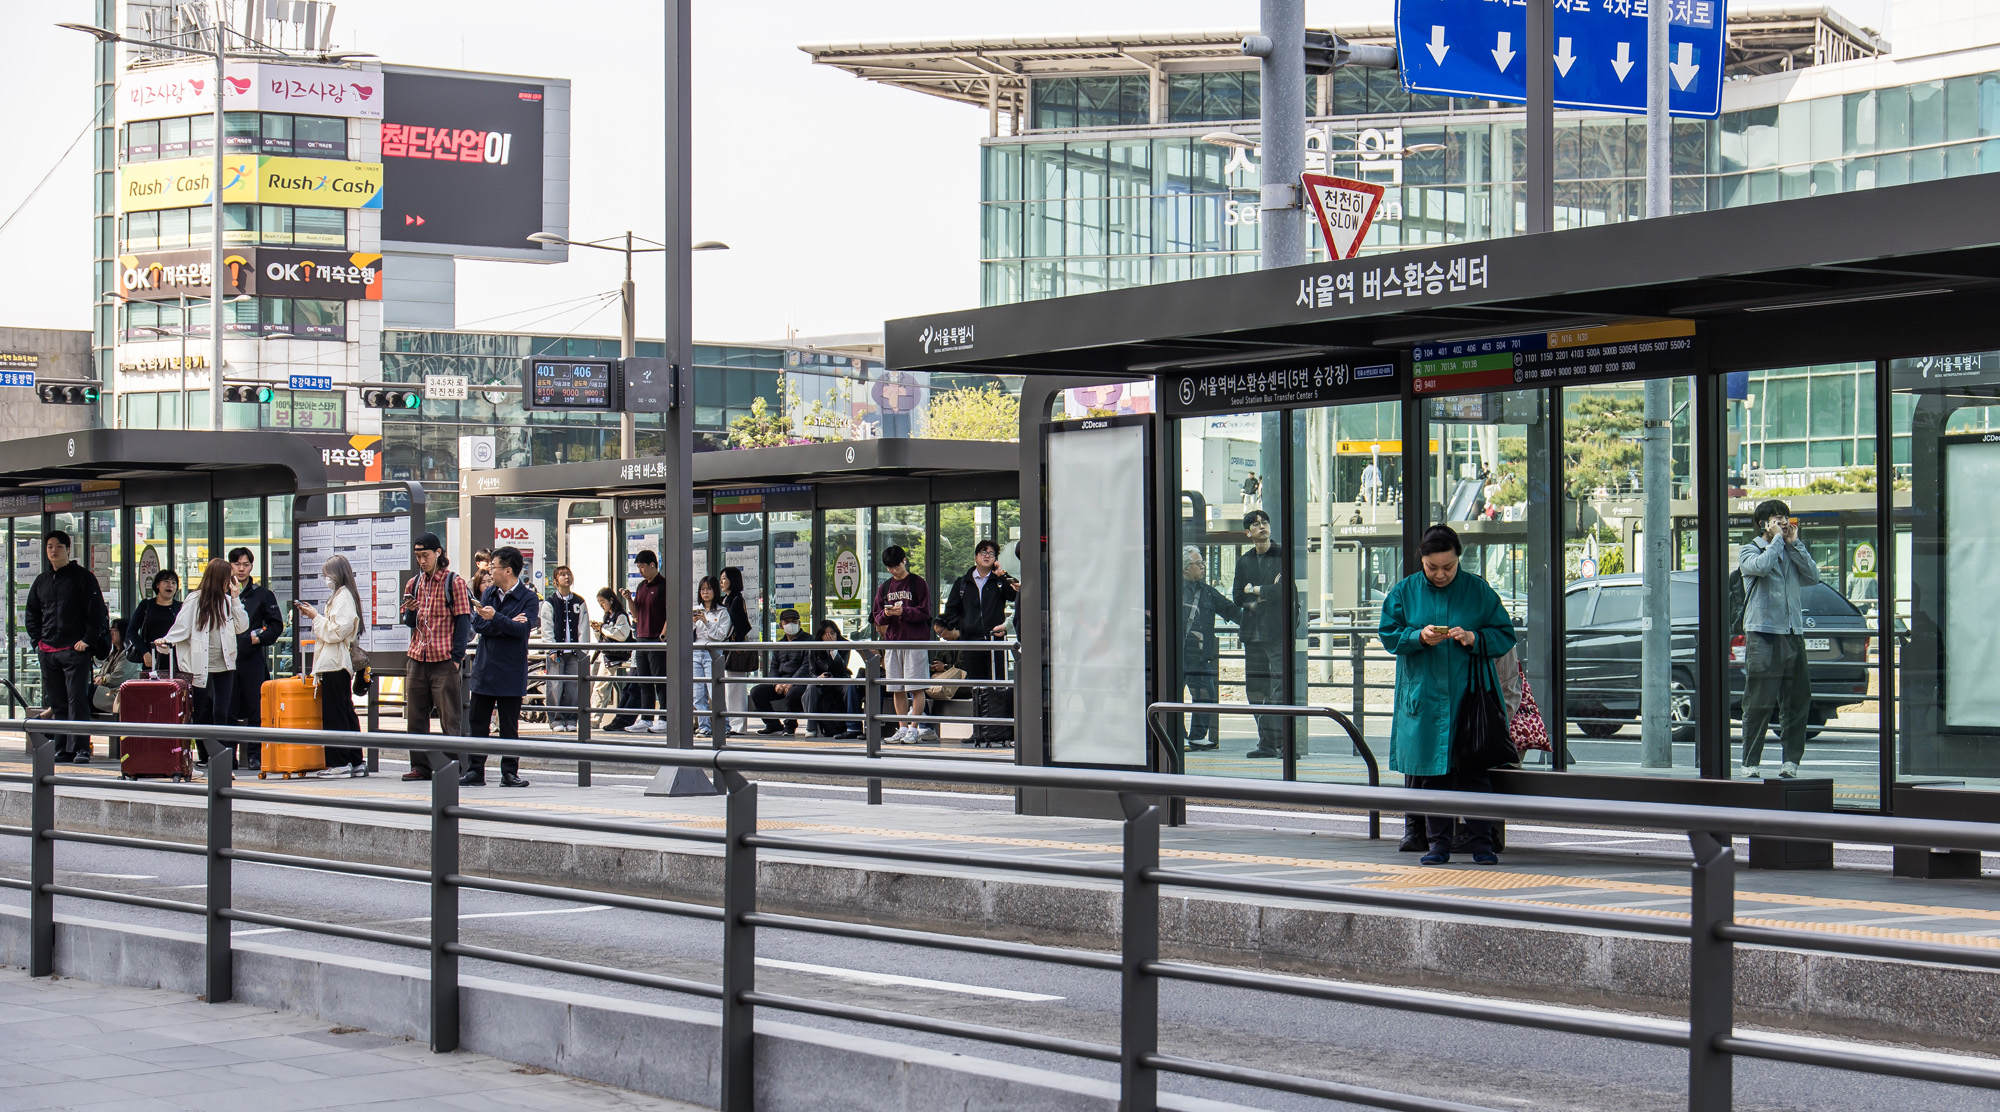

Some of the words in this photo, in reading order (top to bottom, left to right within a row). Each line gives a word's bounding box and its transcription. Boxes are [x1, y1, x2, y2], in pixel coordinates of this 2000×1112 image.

[131, 79, 186, 107] 미즈사랑
[271, 78, 347, 103] 미즈사랑
[381, 123, 512, 166] 첨단산업이
[130, 179, 162, 196] Rush
[176, 174, 210, 192] Cash
[268, 174, 312, 192] Rush
[332, 178, 375, 194] Cash
[1325, 190, 1364, 214] 천천히
[1330, 211, 1360, 230] SLOW
[1296, 272, 1354, 308] 서울역
[1362, 254, 1488, 300] 버스환승센터
[934, 324, 974, 346] 서울특별시
[1578, 333, 1588, 342] N30
[1453, 346, 1462, 354] 402
[1467, 345, 1476, 353] 406
[1482, 343, 1491, 351] 463
[1512, 340, 1520, 348] 701
[1525, 354, 1537, 362] 1101
[1540, 352, 1553, 361] 1150
[1556, 351, 1568, 360] 3201
[1570, 349, 1584, 358] 4103
[1654, 342, 1668, 351] 5007
[1670, 340, 1690, 349] 5500-2
[538, 366, 554, 376] 401
[1424, 365, 1436, 373] 7011
[1441, 362, 1456, 371] 7013A
[1462, 360, 1477, 369] 7013B
[1525, 370, 1537, 378] 8100
[1558, 367, 1572, 376] 9000
[1573, 366, 1586, 375] 9003
[1589, 364, 1602, 373] 9007
[1605, 363, 1619, 372] 9200
[1622, 361, 1635, 370] 9300
[1934, 355, 1980, 372] 서울특별시
[574, 367, 591, 377] 406
[1313, 364, 1349, 387] 승강장)
[291, 377, 330, 388] 한강대교방면
[1424, 380, 1436, 388] 9401
[429, 388, 464, 397] 직진전용
[1231, 397, 1244, 405] Seoul
[1246, 396, 1262, 404] Station
[1264, 394, 1272, 402] Bus
[1274, 392, 1295, 401] Transfer
[1296, 391, 1313, 400] Center
[1314, 390, 1318, 398] 5
[1082, 421, 1108, 429] JCDecaux
[620, 463, 641, 480] 서울역
[462, 475, 467, 491] 4
[837, 562, 848, 574] 금연
[573, 604, 580, 613] C
[1810, 640, 1826, 648] 7699
